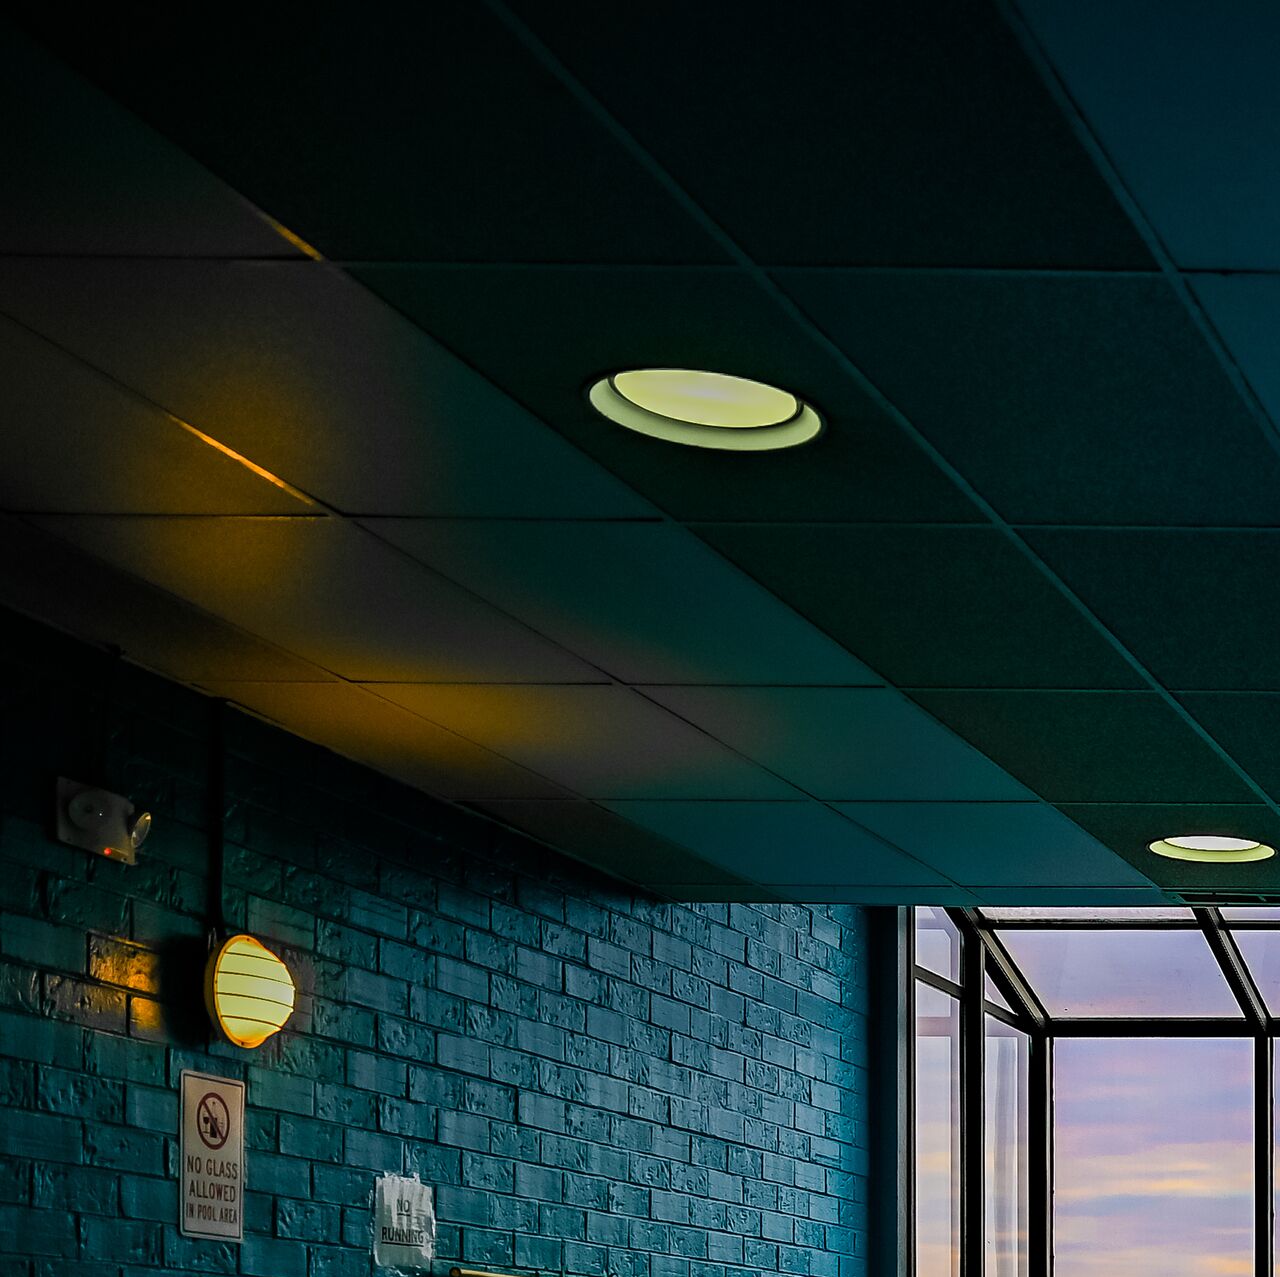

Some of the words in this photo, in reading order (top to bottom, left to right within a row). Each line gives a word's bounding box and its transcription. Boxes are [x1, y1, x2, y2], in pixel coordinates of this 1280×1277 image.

[187, 1155, 202, 1174] NO
[206, 1158, 238, 1180] GLASS
[189, 1180, 236, 1202] ALLOWED
[186, 1202, 194, 1218] IN
[197, 1204, 217, 1222] POOL
[219, 1207, 238, 1224] AREA
[397, 1198, 410, 1213] NO
[381, 1226, 425, 1244] RUNNING
